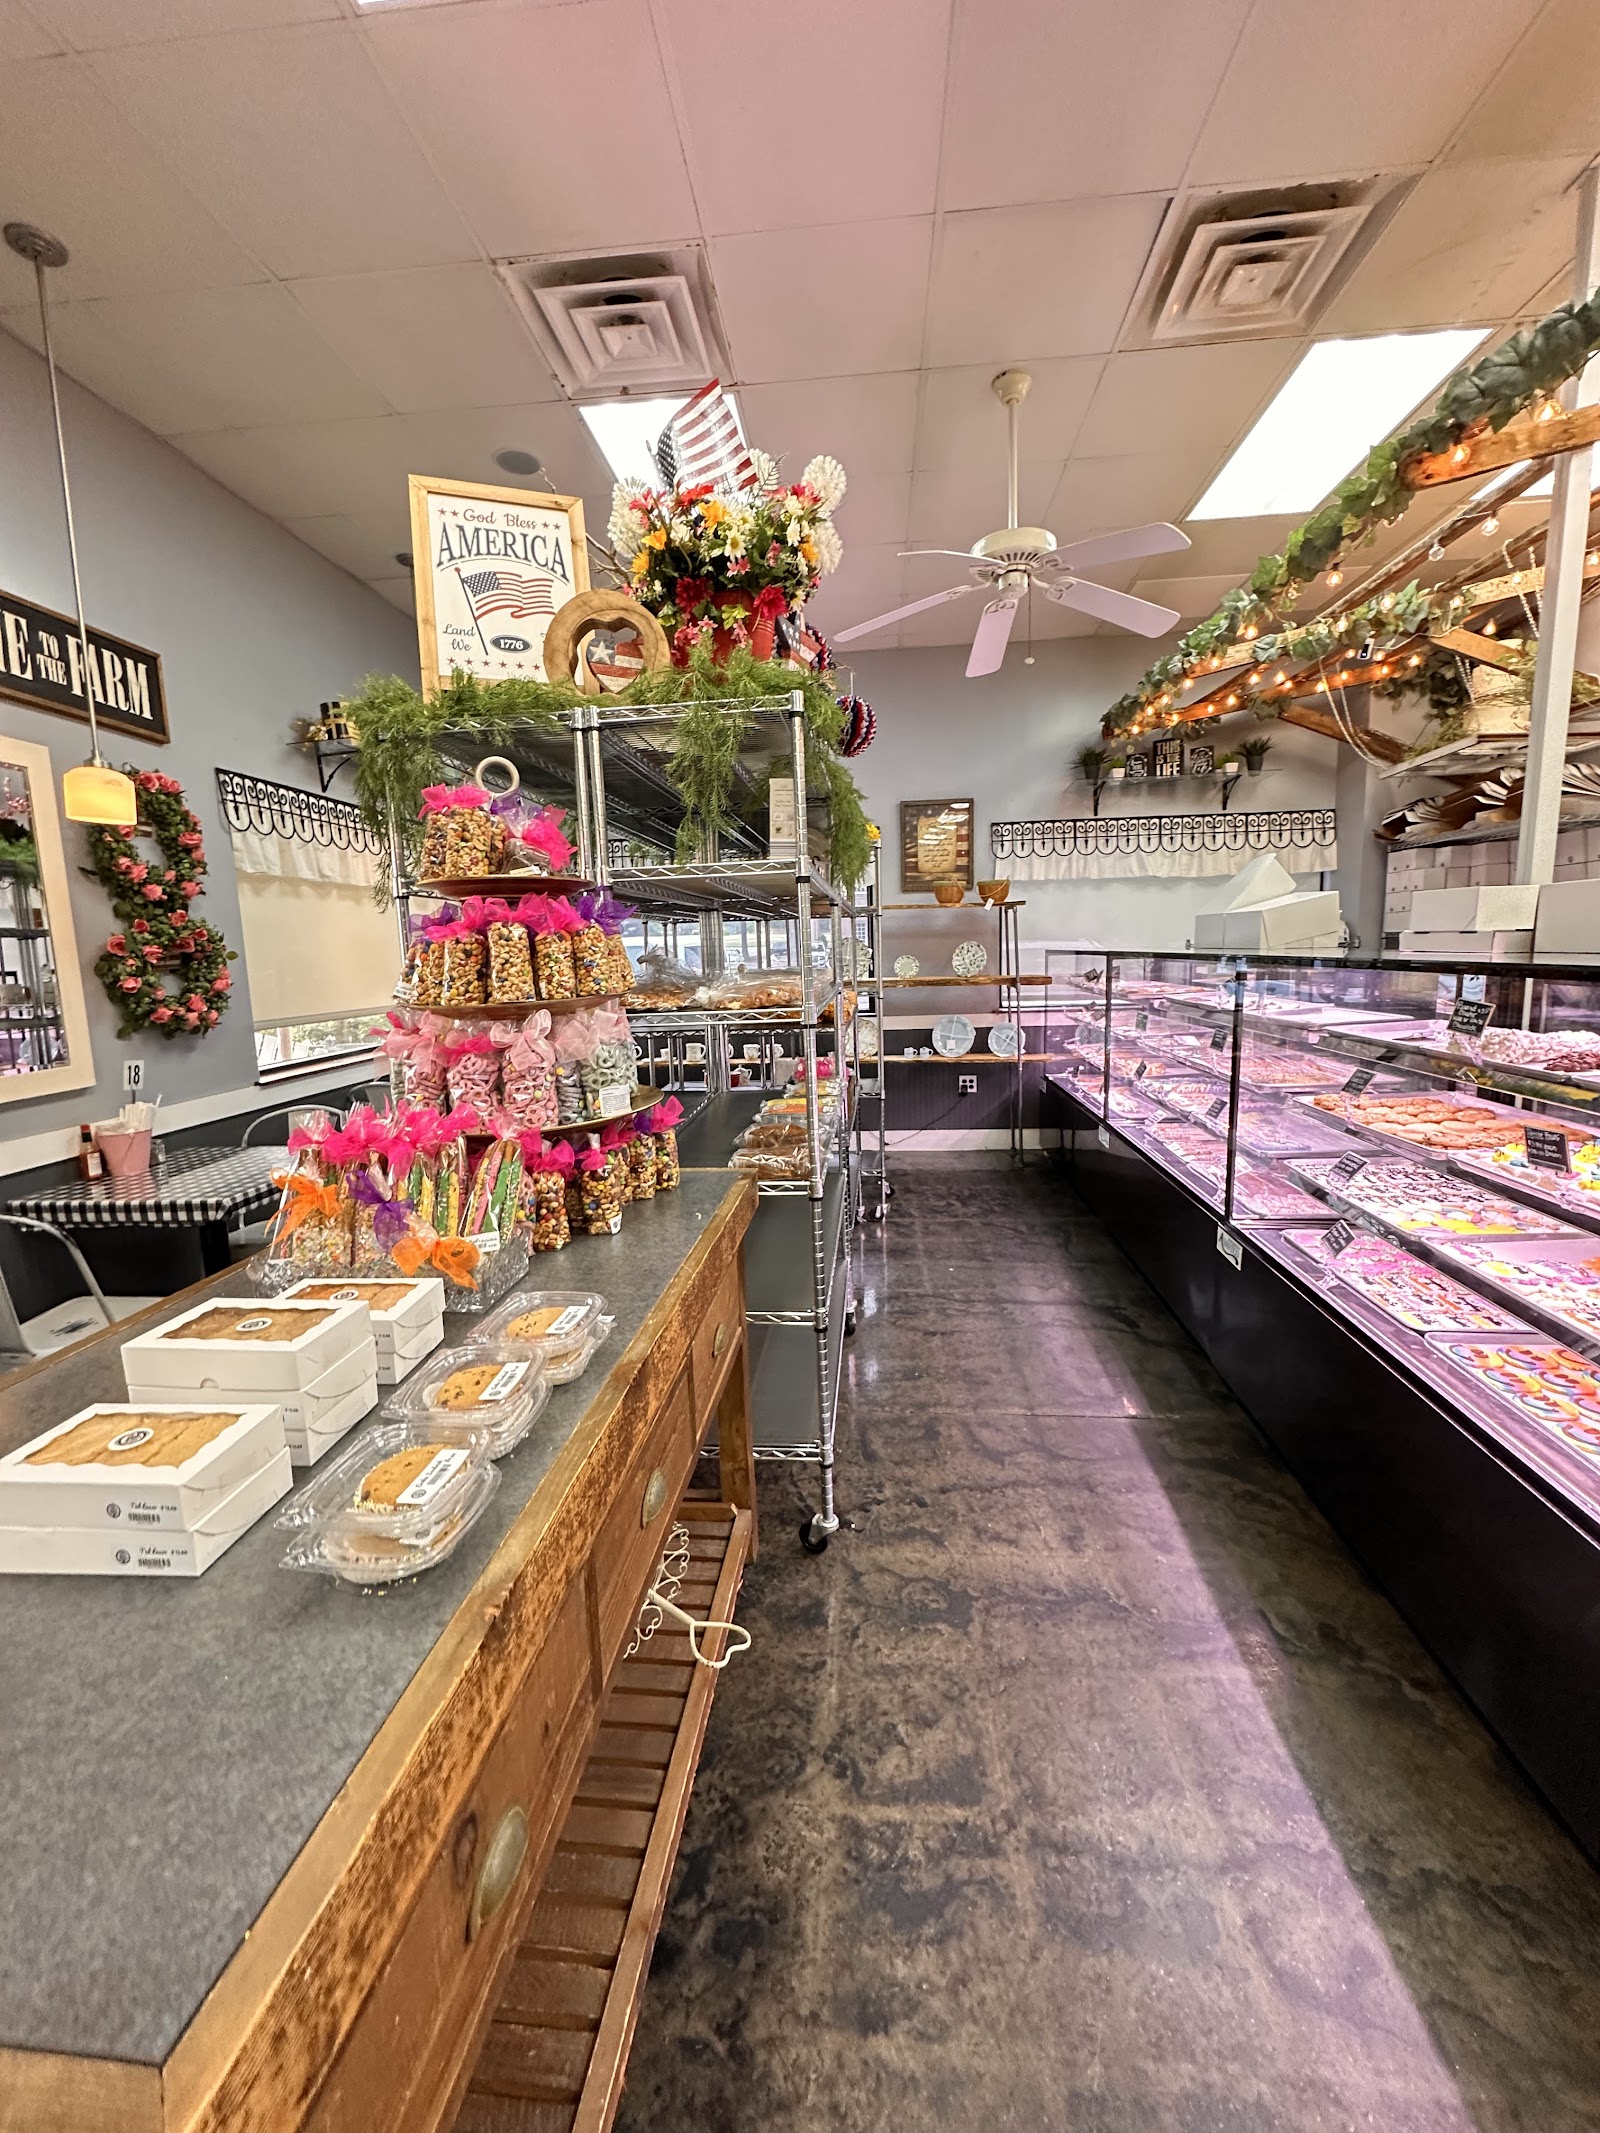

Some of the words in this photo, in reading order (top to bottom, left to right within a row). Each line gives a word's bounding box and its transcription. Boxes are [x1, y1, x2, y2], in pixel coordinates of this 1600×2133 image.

[463, 508, 497, 524] God
[504, 513, 538, 530] Bless
[436, 522, 570, 583] AMERICA
[442, 624, 476, 637] Land
[38, 630, 59, 659] TO
[451, 639, 472, 651] We
[499, 639, 524, 651] 1776
[36, 653, 67, 685] THE
[65, 634, 154, 720] FARM
[1166, 752, 1180, 763] TE
[127, 1065, 140, 1085] 18
